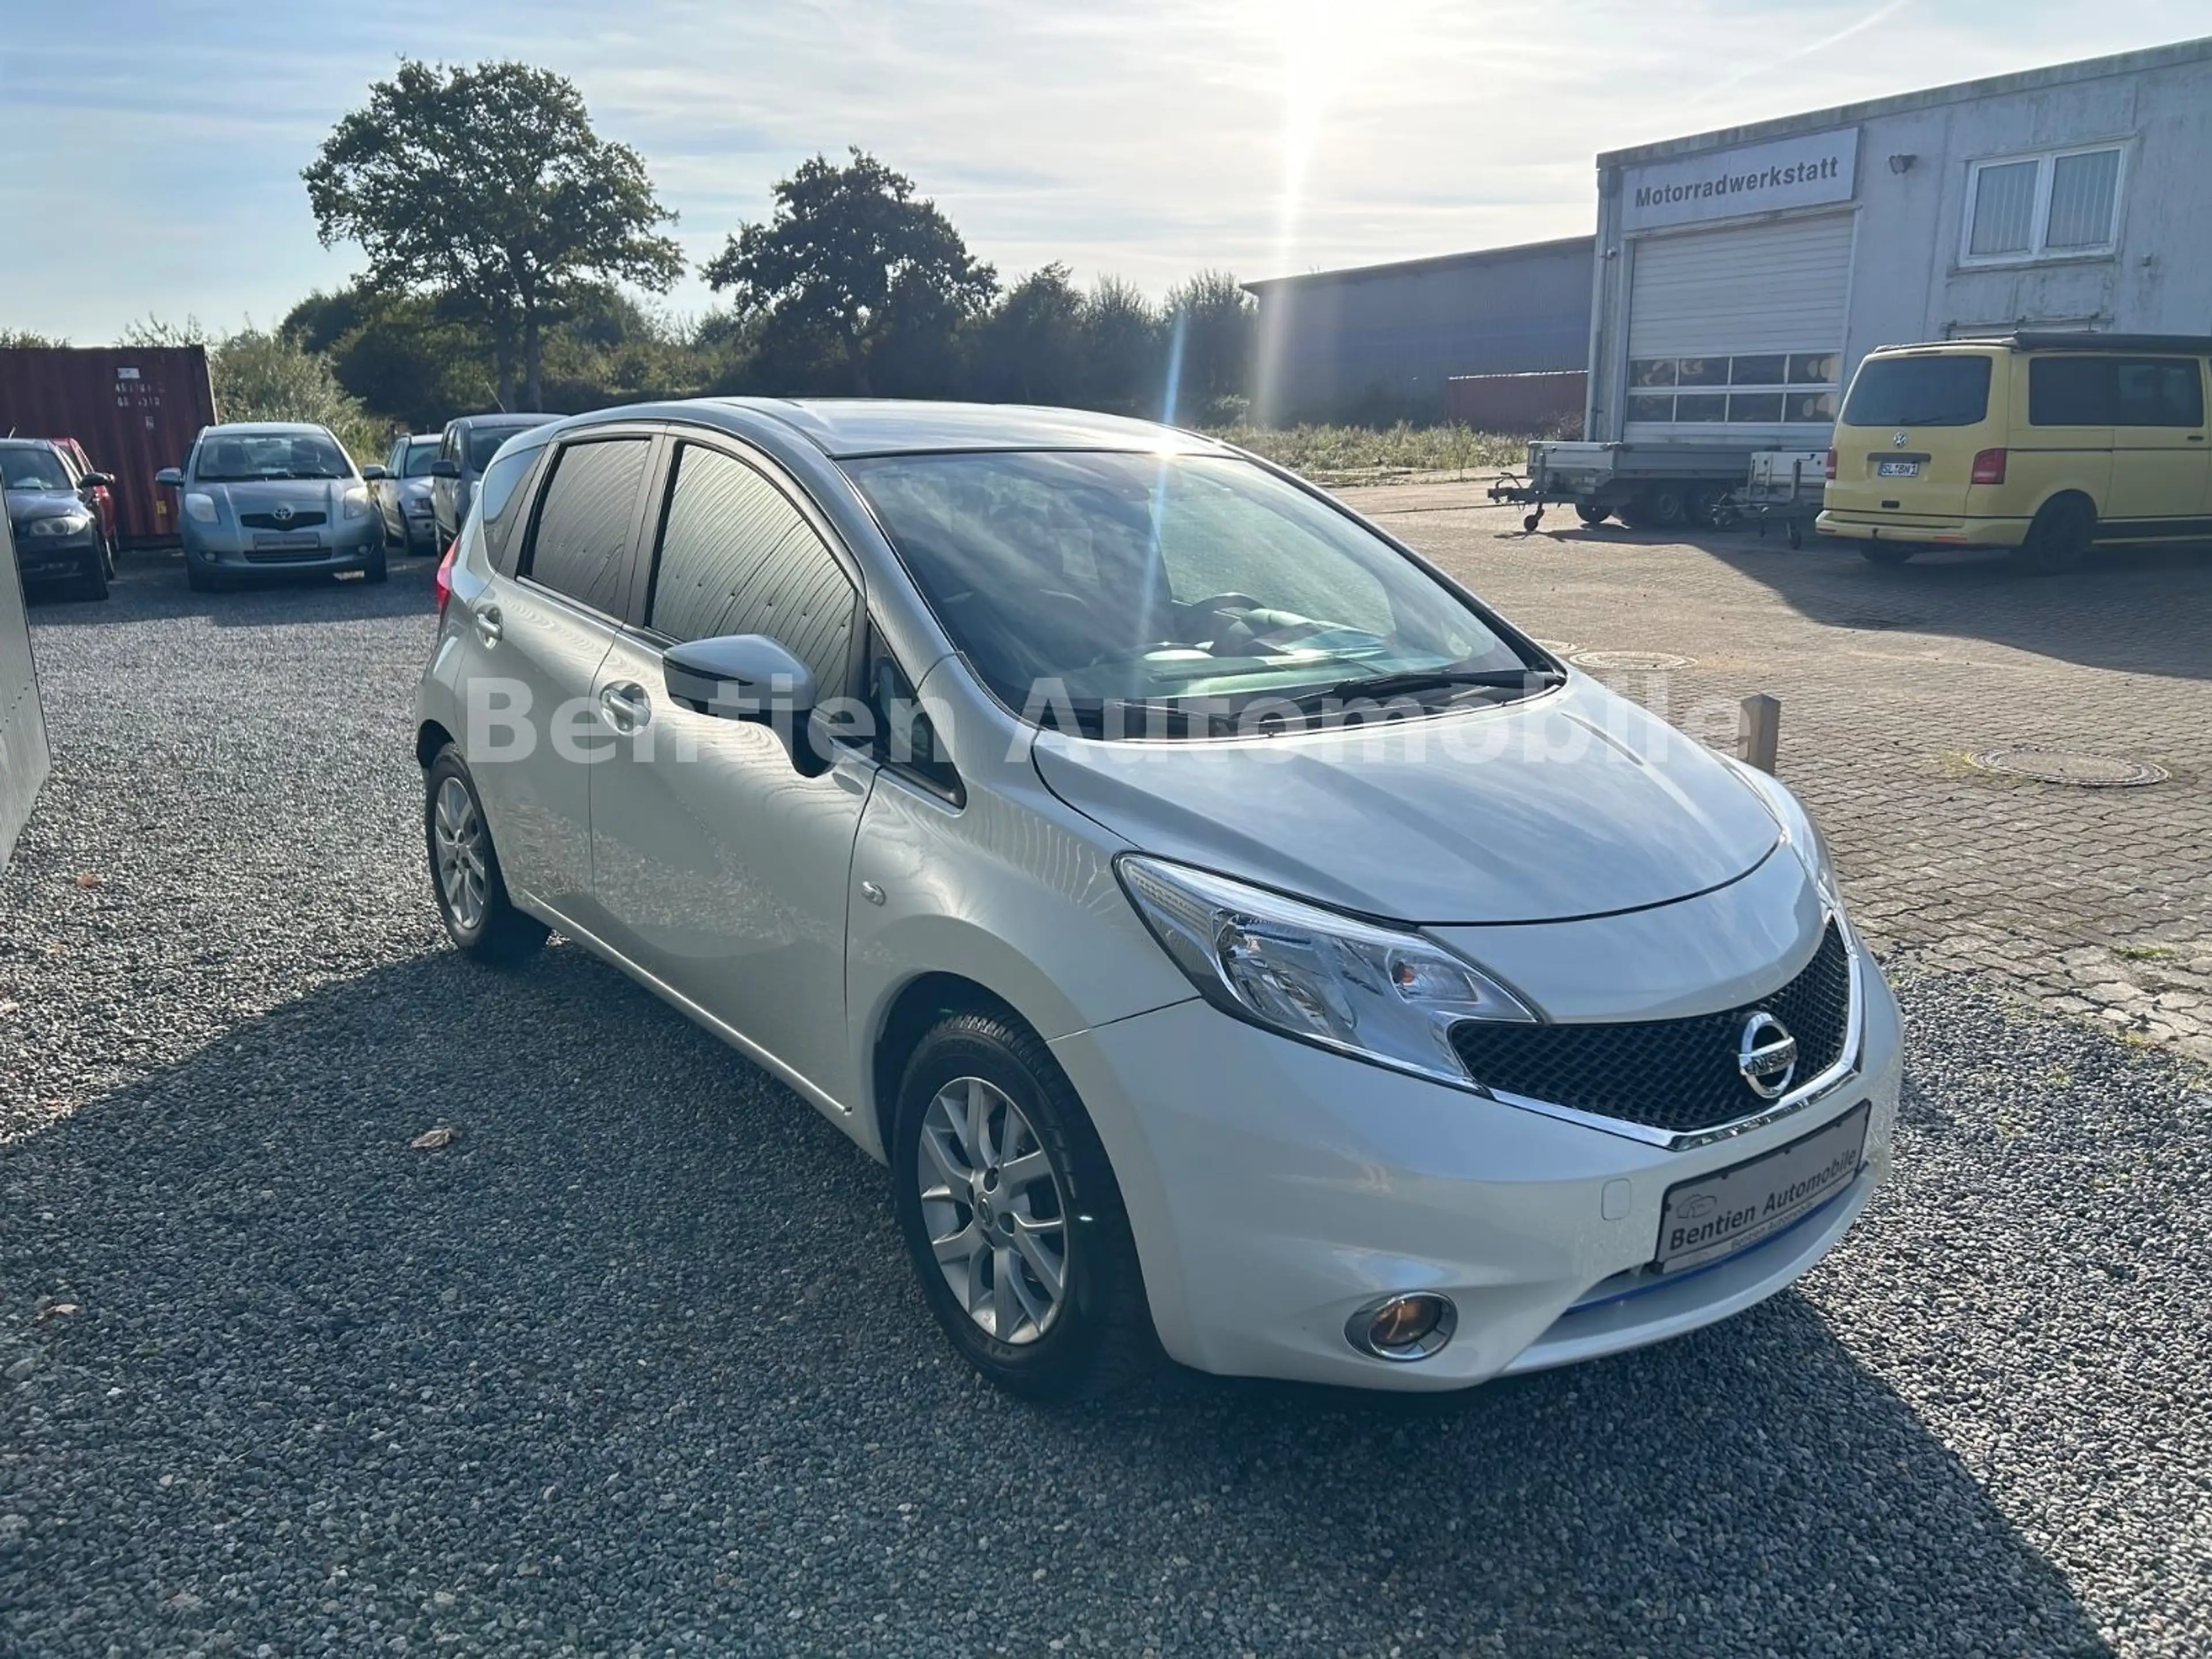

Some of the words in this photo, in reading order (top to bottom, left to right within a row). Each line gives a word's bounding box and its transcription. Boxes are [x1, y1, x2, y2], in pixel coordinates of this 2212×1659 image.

[1635, 156, 1838, 208] Motorradwerkstatt
[1669, 1205, 1756, 1251] Bentien
[1763, 1149, 1857, 1215] Automobile
